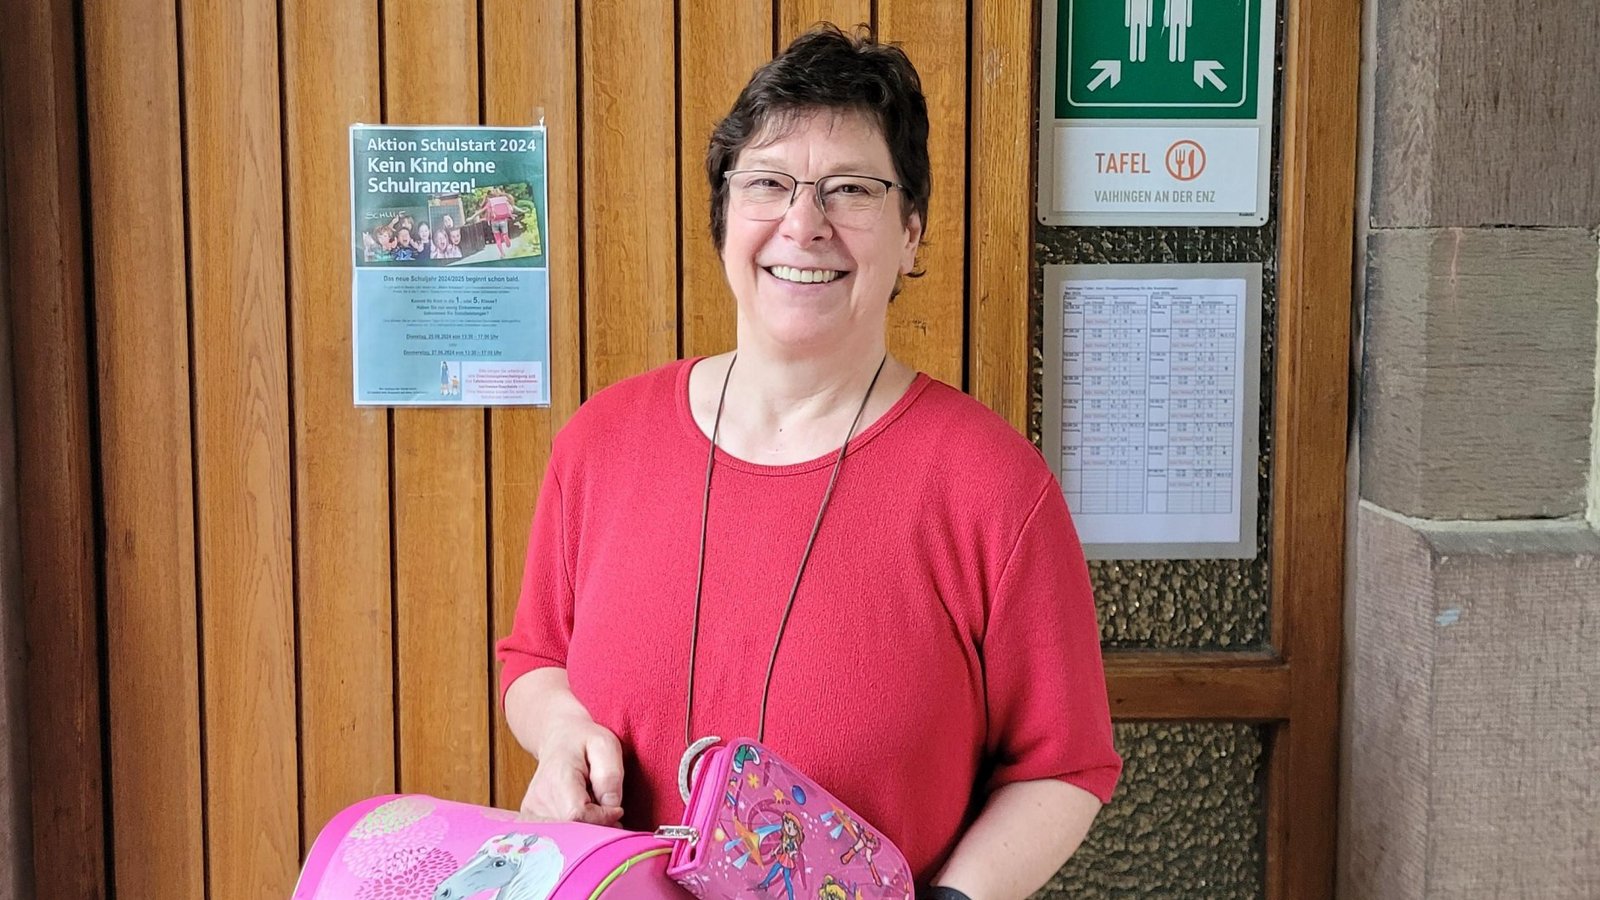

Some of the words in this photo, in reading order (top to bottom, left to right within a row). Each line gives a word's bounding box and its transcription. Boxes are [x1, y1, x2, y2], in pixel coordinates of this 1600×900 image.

[368, 138, 416, 152] Aktion
[421, 138, 496, 152] Schulstart
[500, 138, 536, 152] 2024
[368, 157, 405, 173] Kein
[410, 157, 448, 173] Kind
[452, 157, 496, 173] ohne
[1094, 153, 1150, 174] TAFEL
[368, 177, 476, 193] Schulranzen!
[1094, 190, 1151, 202] VAIHINGEN
[1154, 190, 1170, 202] AN
[1172, 190, 1192, 202] DER
[1196, 190, 1216, 202] ENZ
